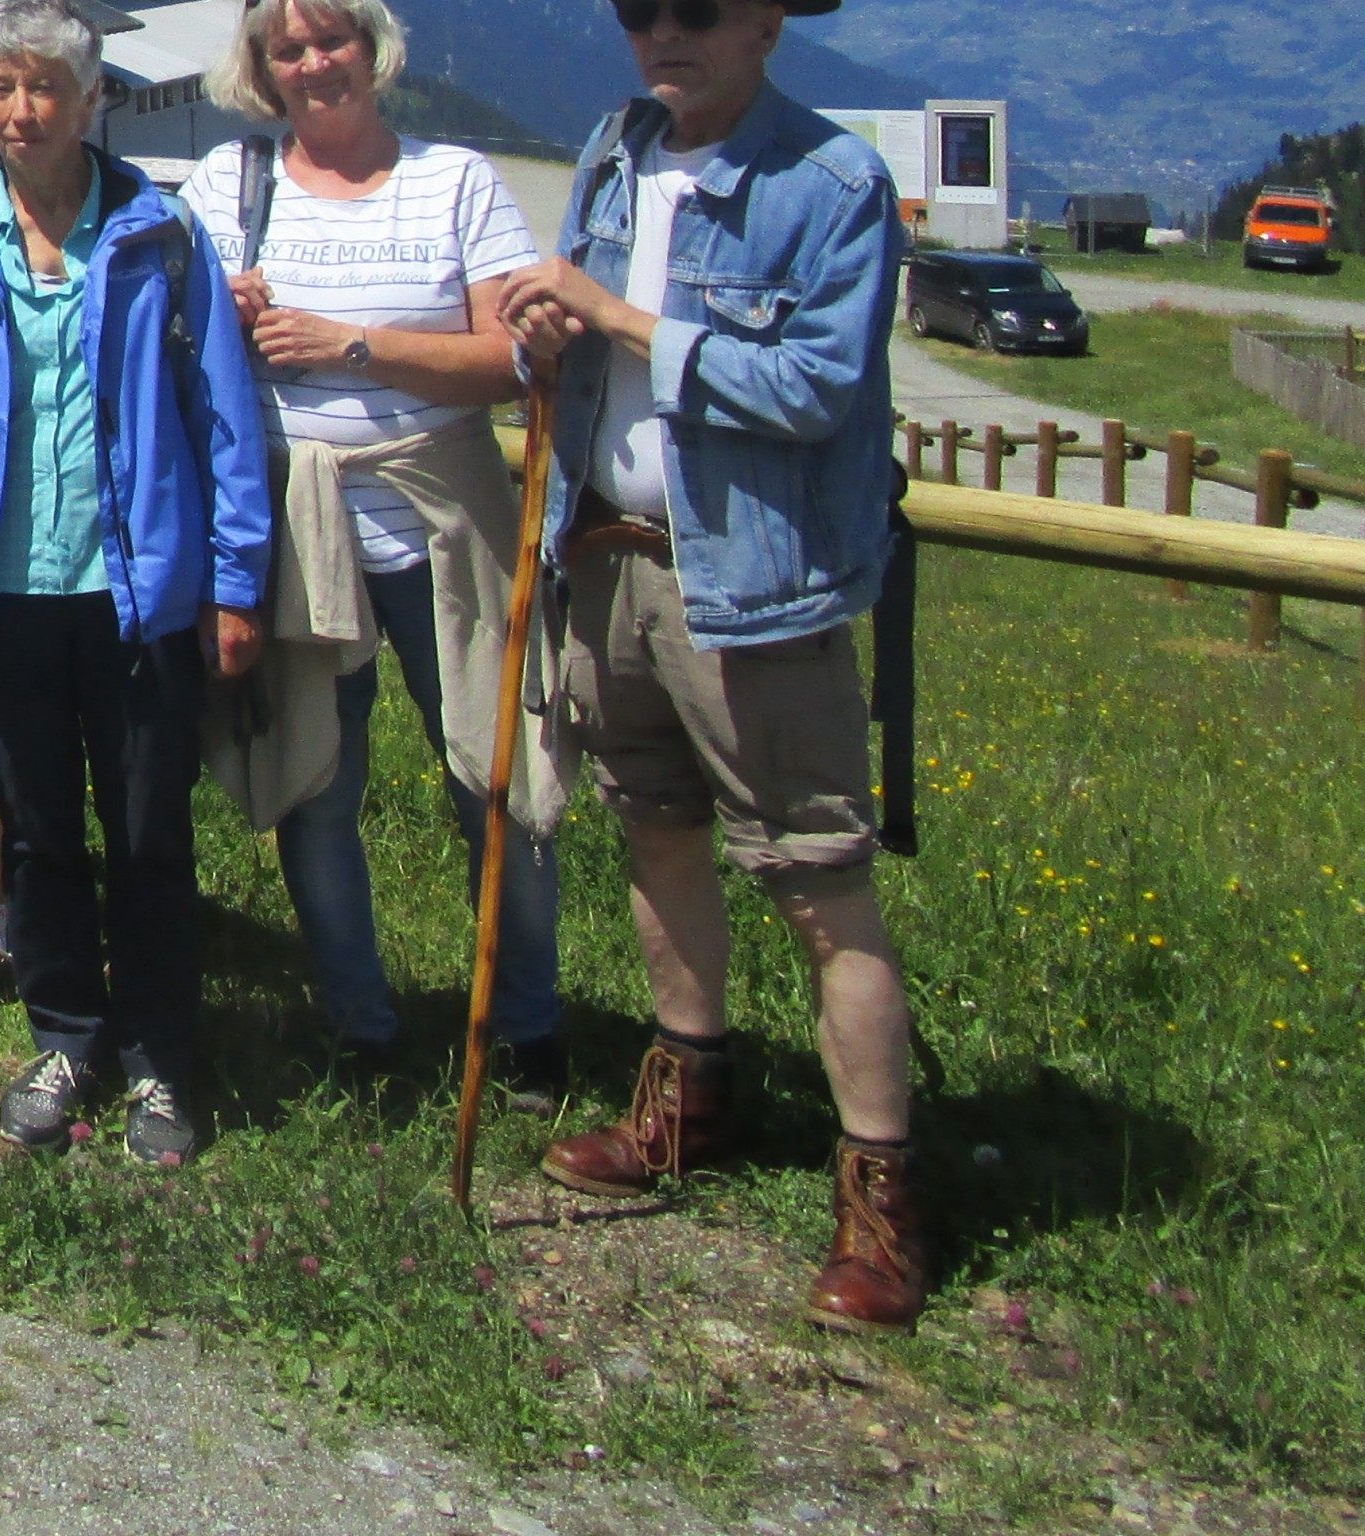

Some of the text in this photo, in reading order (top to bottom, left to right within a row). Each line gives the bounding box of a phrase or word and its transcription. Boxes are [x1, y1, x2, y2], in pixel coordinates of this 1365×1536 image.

[218, 238, 441, 264] ENOY THE MOMENT
[307, 274, 334, 286] are
[338, 269, 364, 287] the
